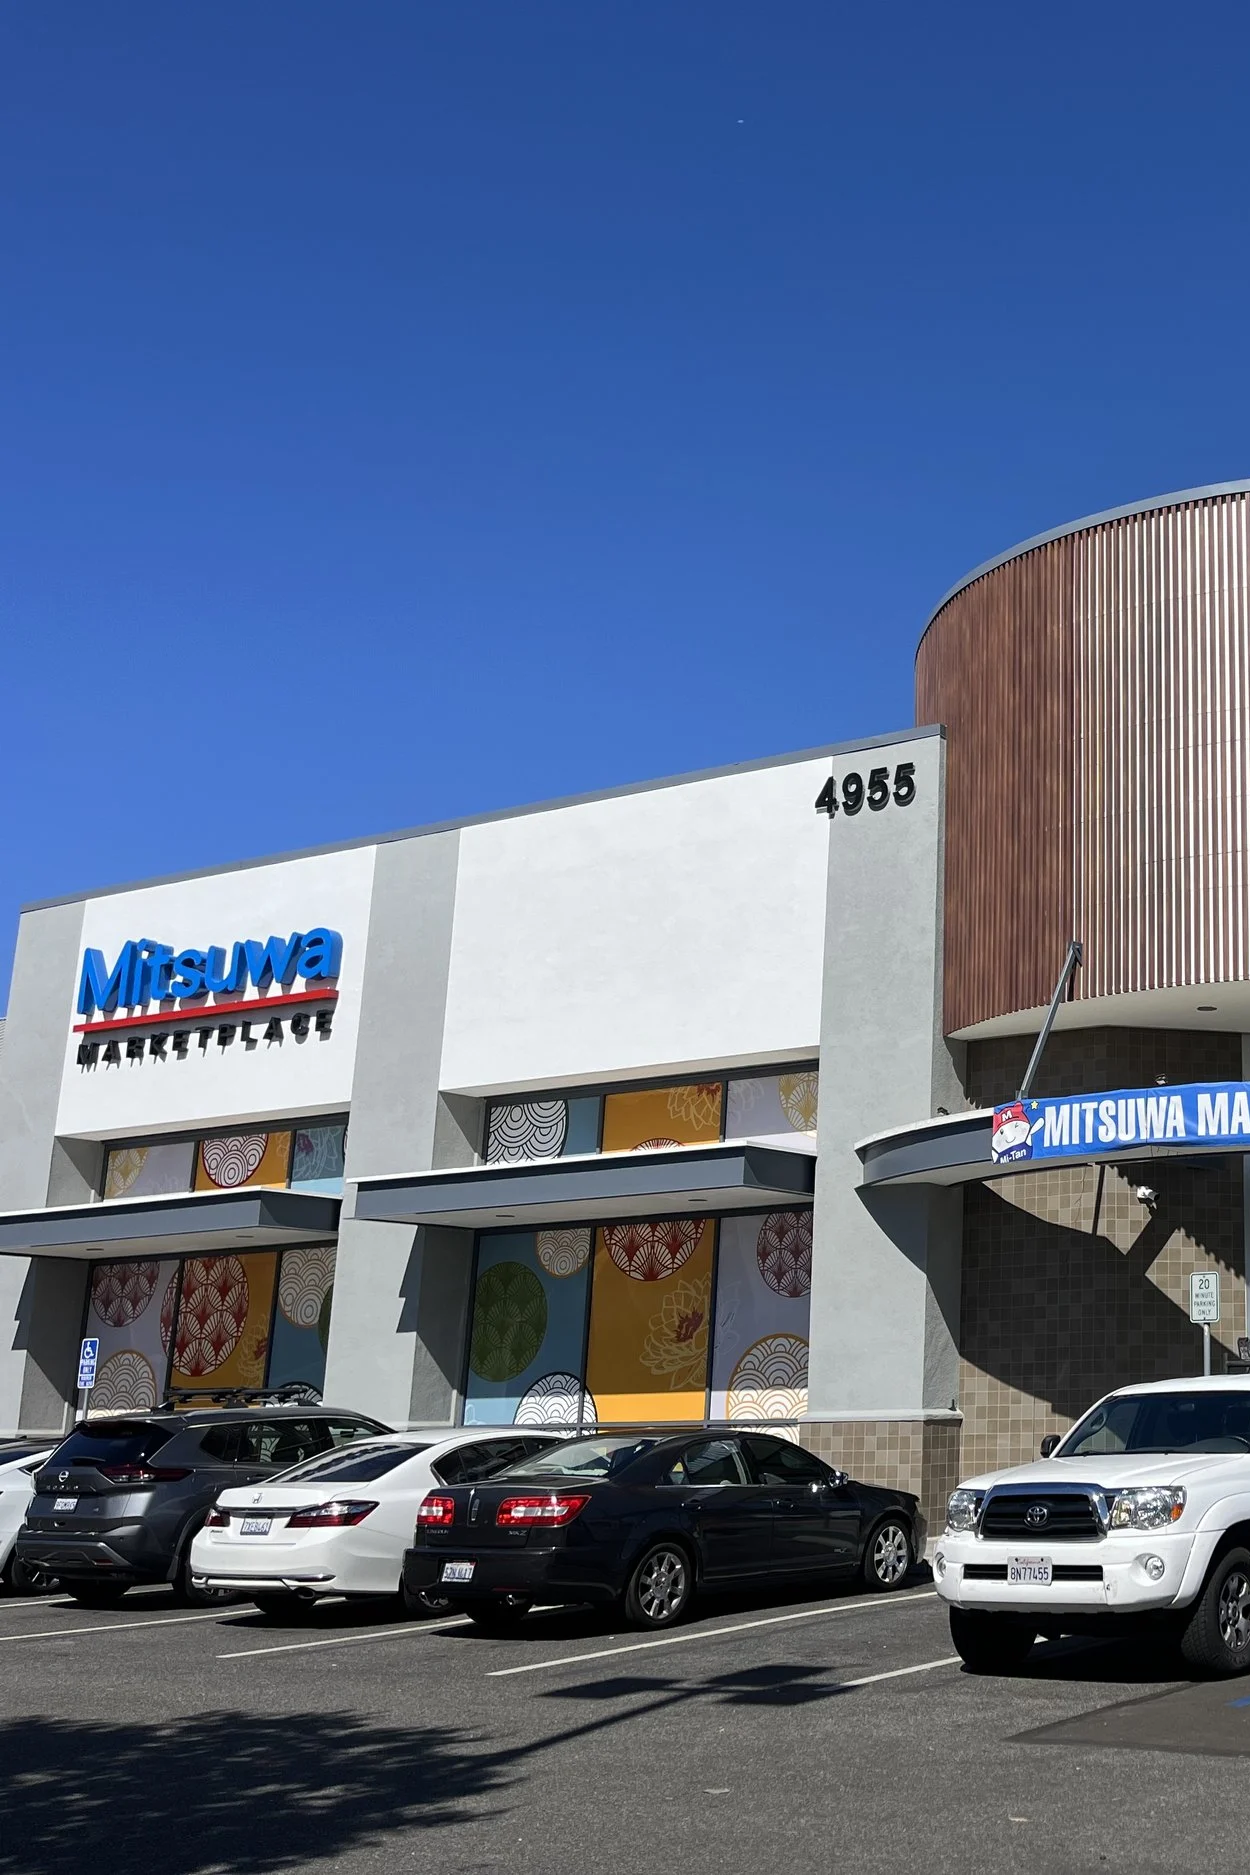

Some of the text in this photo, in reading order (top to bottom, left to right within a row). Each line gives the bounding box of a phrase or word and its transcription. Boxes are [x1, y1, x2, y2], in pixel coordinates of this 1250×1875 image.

[815, 762, 916, 819] 4955
[77, 927, 343, 1015] Mitsuwa
[76, 1009, 335, 1066] MARKETPLACE
[1043, 1095, 1186, 1147] MITSUWA
[1000, 1149, 1027, 1163] Mi-Tan
[1199, 1279, 1210, 1290] 20
[1010, 1567, 1049, 1581] 8N77455
